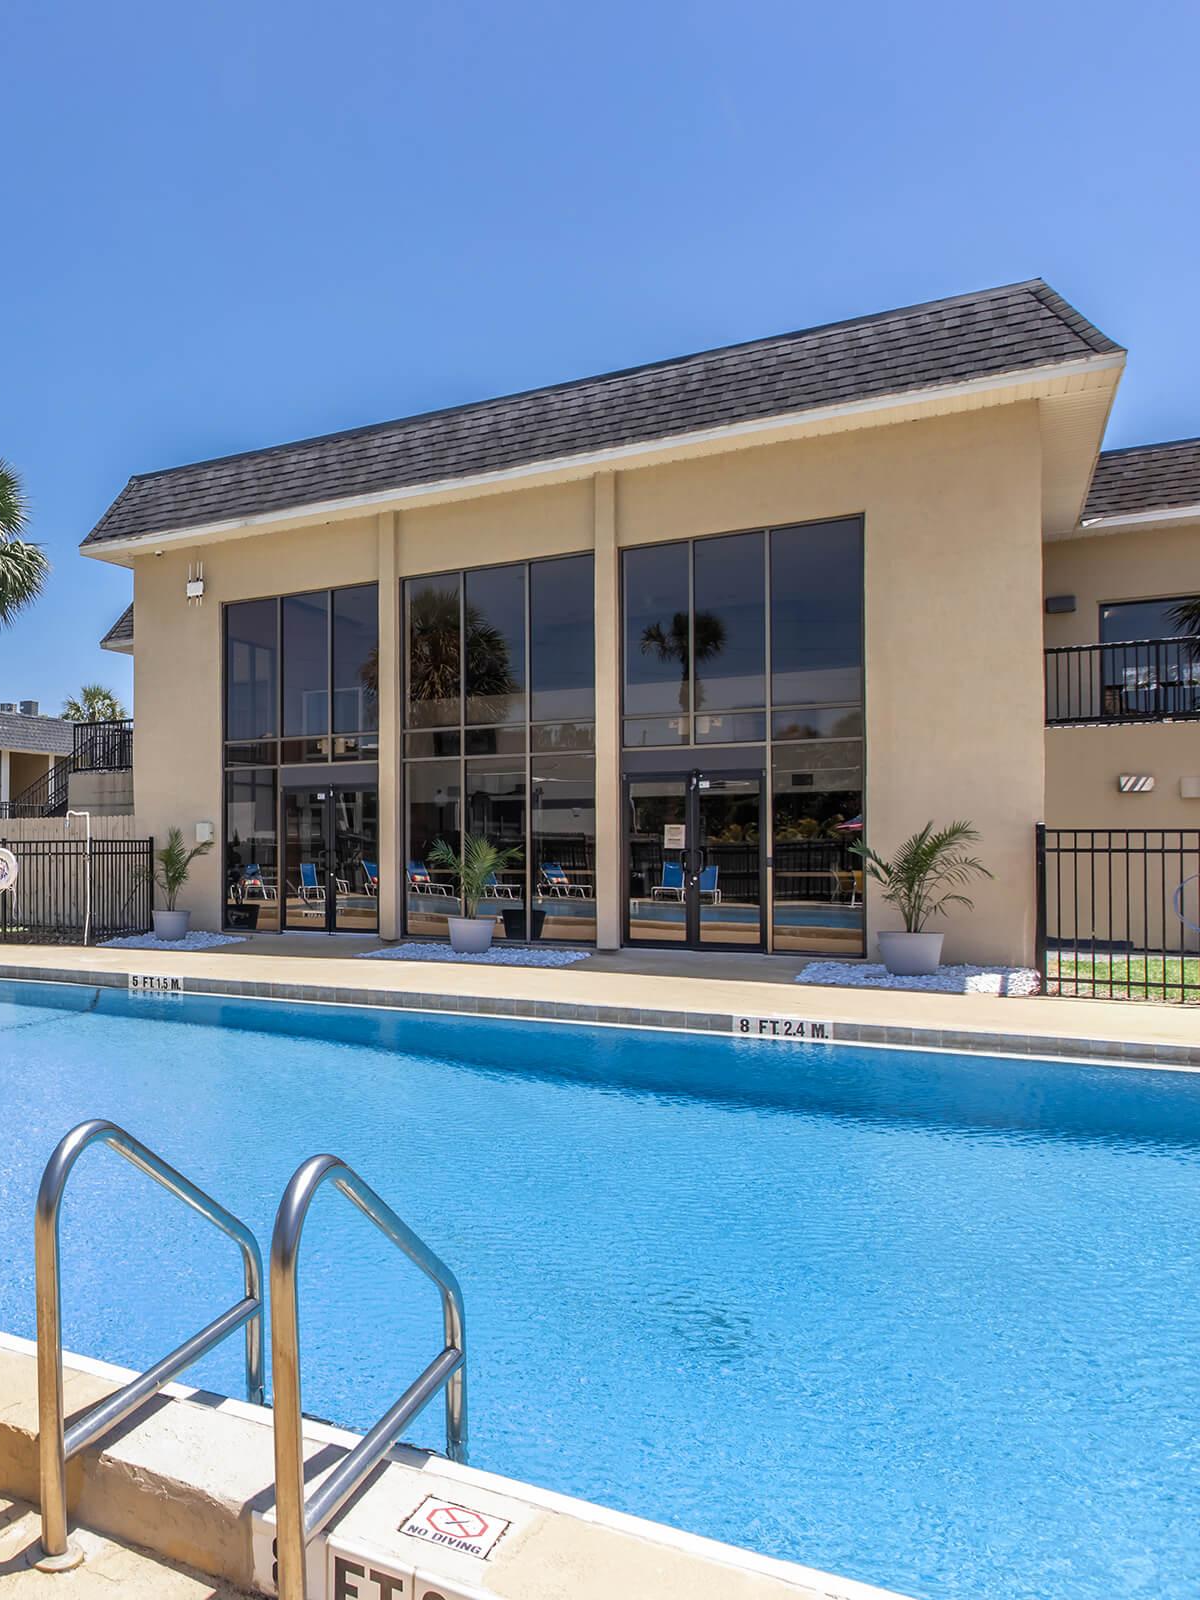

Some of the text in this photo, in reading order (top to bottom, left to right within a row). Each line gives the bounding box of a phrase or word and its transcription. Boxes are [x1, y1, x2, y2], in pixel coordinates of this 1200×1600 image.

[132, 976, 138, 987] 5
[157, 978, 168, 989] 1.5
[171, 978, 181, 990] M.
[740, 1018, 749, 1033] 8
[784, 1021, 805, 1037] 2.4
[811, 1023, 829, 1039] M.
[407, 1524, 482, 1555] NO DIVING
